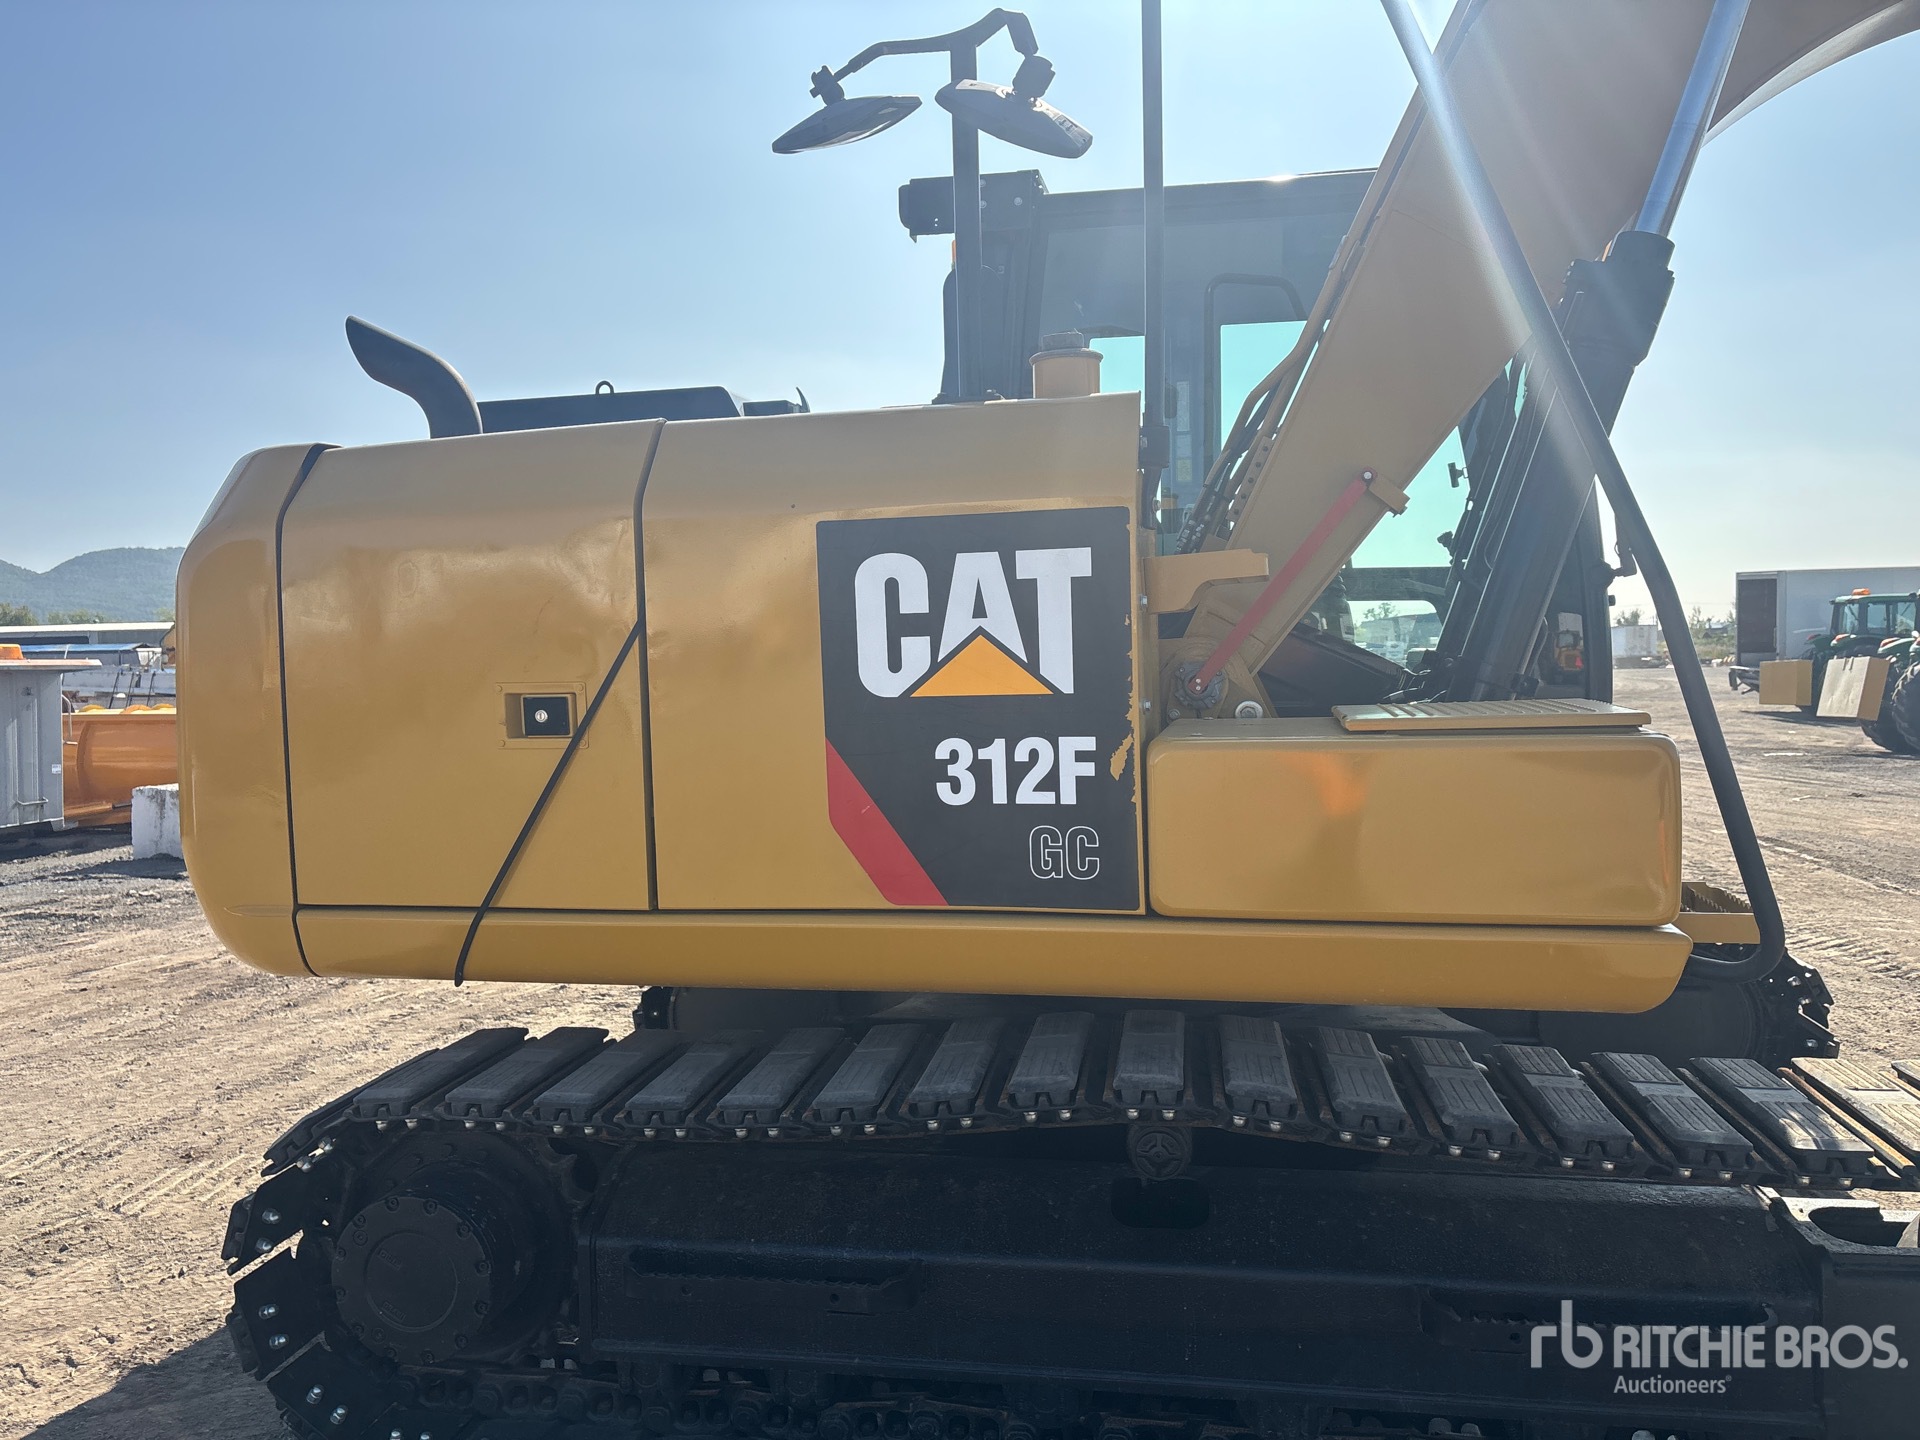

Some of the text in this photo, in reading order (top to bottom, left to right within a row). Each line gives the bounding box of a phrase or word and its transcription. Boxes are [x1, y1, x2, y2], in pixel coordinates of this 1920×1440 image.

[854, 546, 1091, 698] CAT
[934, 736, 1096, 805] 312F
[1029, 825, 1100, 880] GC
